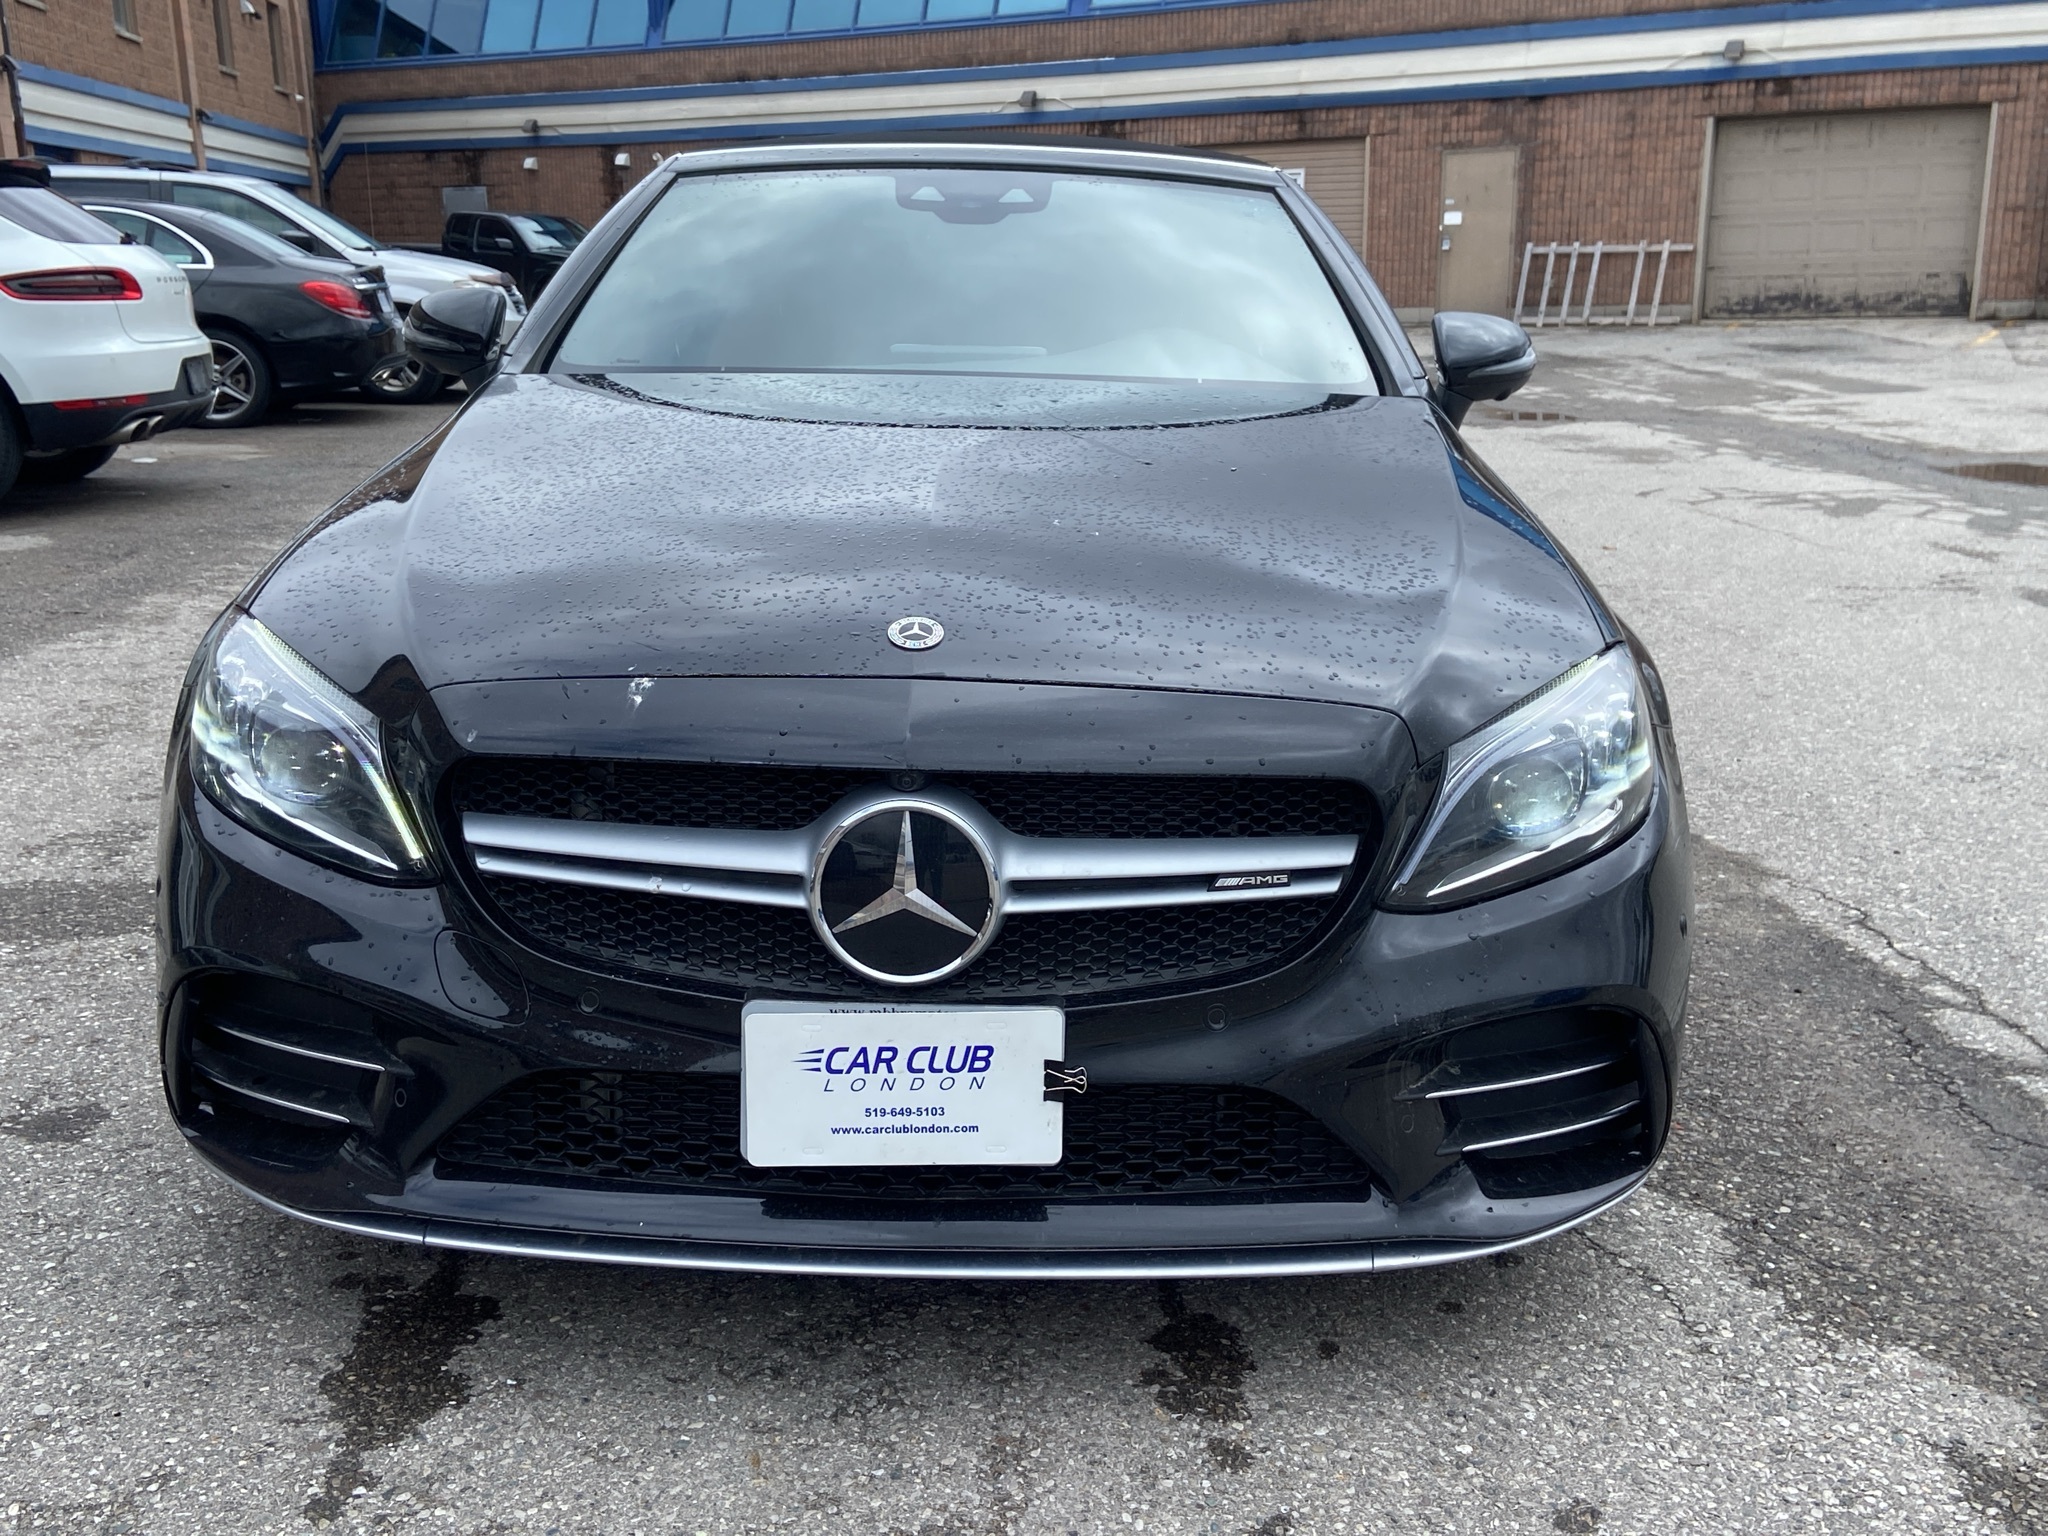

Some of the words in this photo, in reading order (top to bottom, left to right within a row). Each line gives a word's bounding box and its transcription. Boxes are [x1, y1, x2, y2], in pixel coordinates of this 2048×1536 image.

[1238, 875, 1288, 886] AMG
[825, 1046, 899, 1074] CAR
[906, 1045, 995, 1074] CLUB
[824, 1077, 986, 1092] LONDON
[865, 1107, 945, 1118] 519-649-5103
[831, 1124, 979, 1135] www.carclublondon.com
